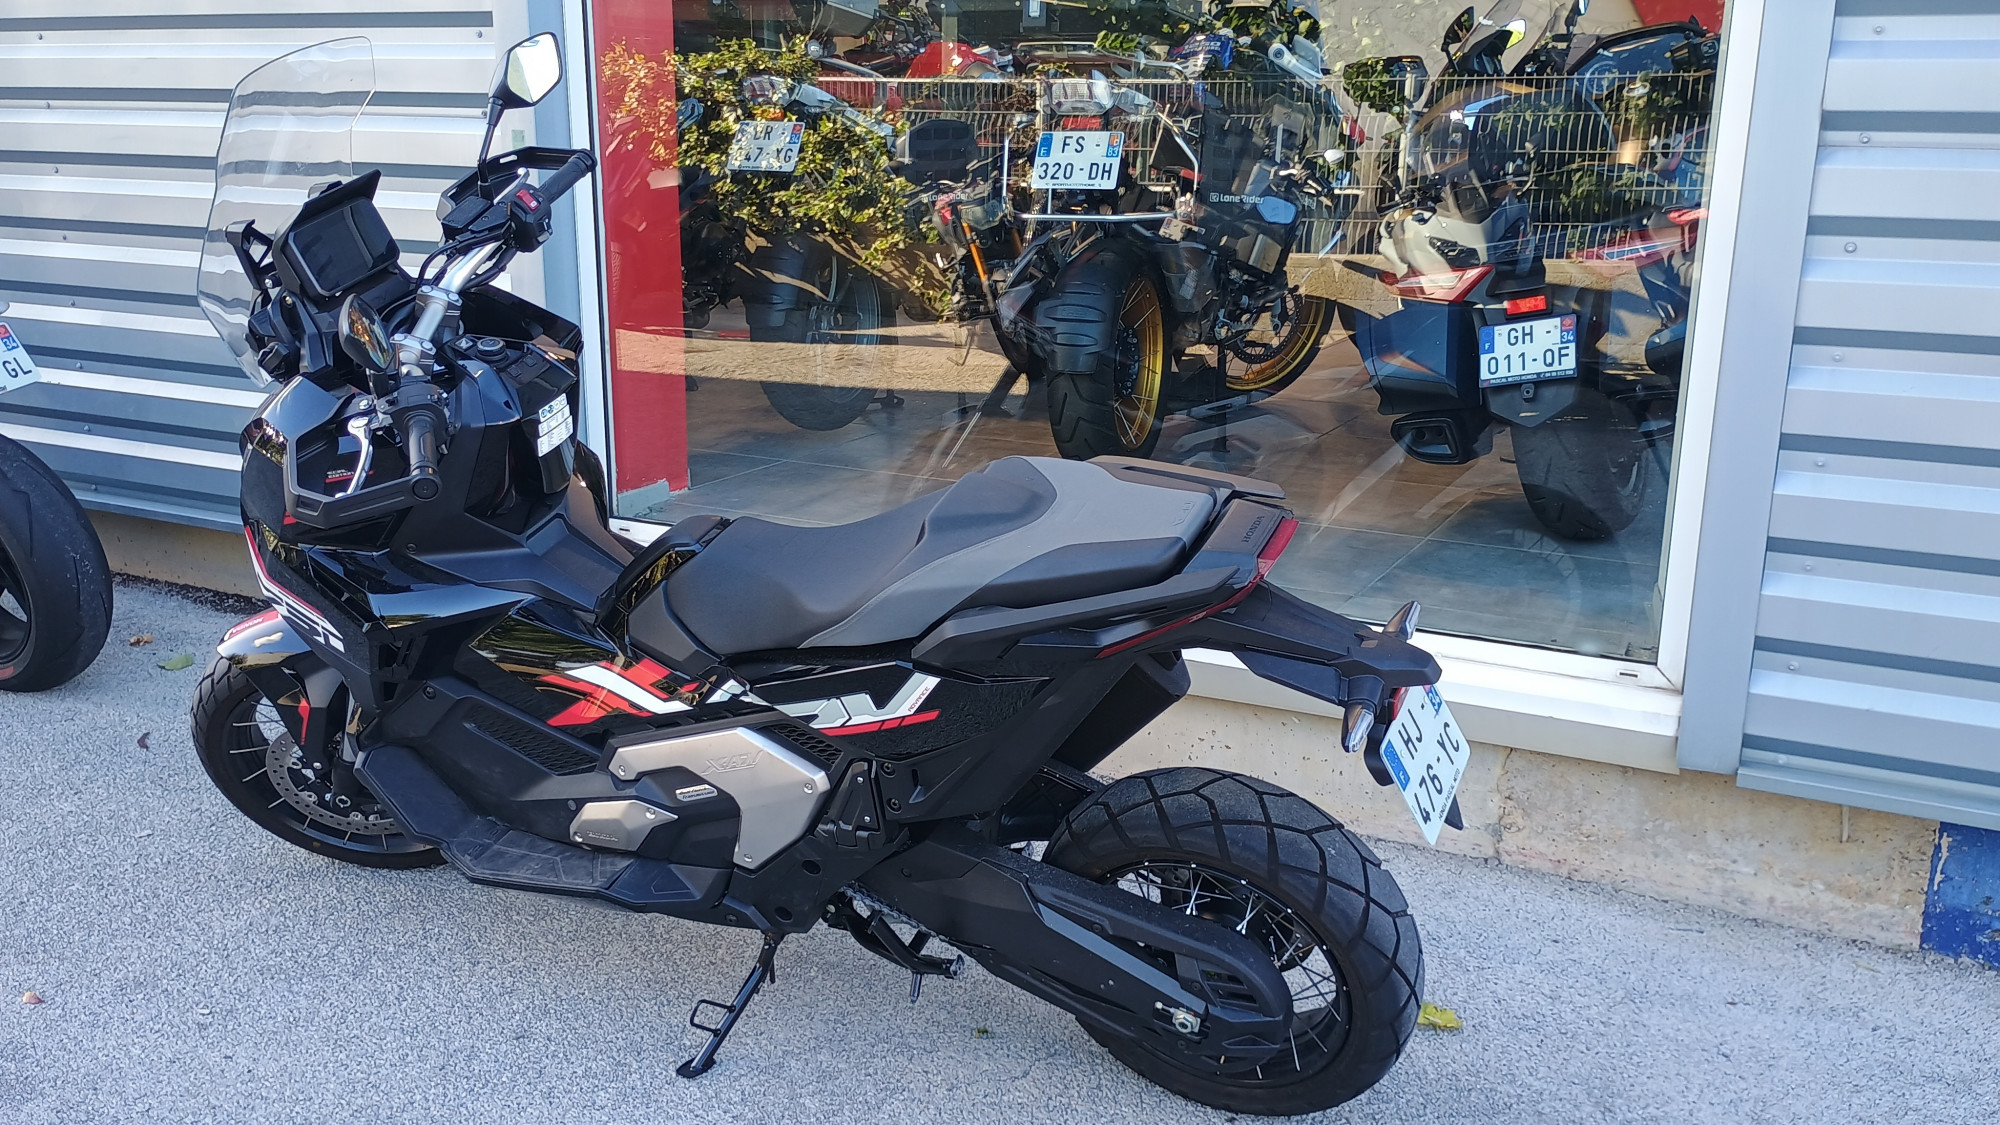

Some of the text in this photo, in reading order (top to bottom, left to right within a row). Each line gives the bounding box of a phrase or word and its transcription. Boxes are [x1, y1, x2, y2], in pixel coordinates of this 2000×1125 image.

[789, 134, 799, 143] 34
[1061, 135, 1086, 154] FS
[1107, 147, 1119, 157] 83
[1038, 162, 1113, 181] 320-DH
[2, 336, 18, 350] 34
[1507, 324, 1534, 347] GH
[1561, 331, 1574, 342] 34
[1485, 342, 1491, 350] F
[2, 356, 33, 379] GL
[1487, 345, 1570, 375] 011-QF
[1241, 515, 1265, 543] HONDA
[1398, 708, 1423, 761] HJ
[1399, 769, 1406, 784] F
